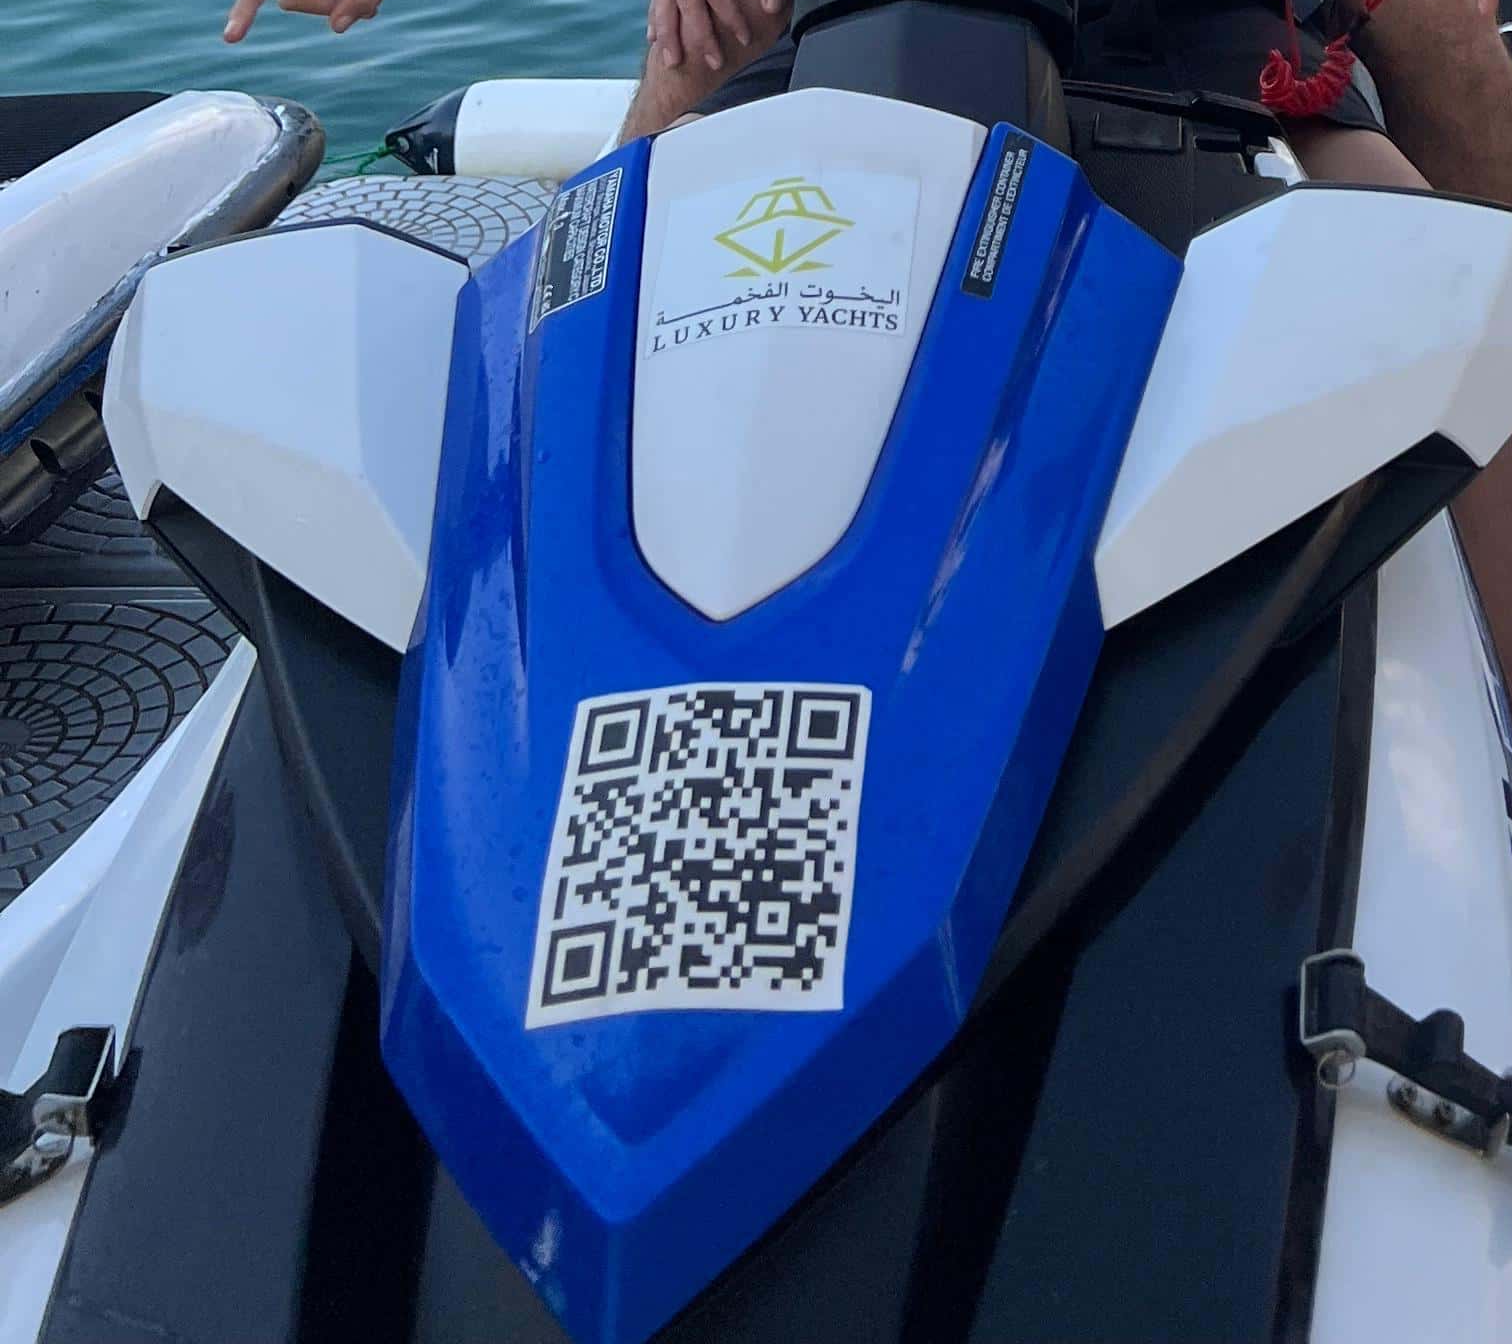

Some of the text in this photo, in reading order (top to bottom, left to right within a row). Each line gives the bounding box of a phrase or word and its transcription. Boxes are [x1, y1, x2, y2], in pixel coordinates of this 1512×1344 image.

[602, 171, 618, 212] YAMAHA
[597, 212, 610, 248] MOTOR
[970, 151, 1015, 279] FIRE EXTINGUISHER CONTAINER
[655, 281, 900, 326] اليخوت الفخمة
[652, 305, 899, 353] LUXURY YACHTS
